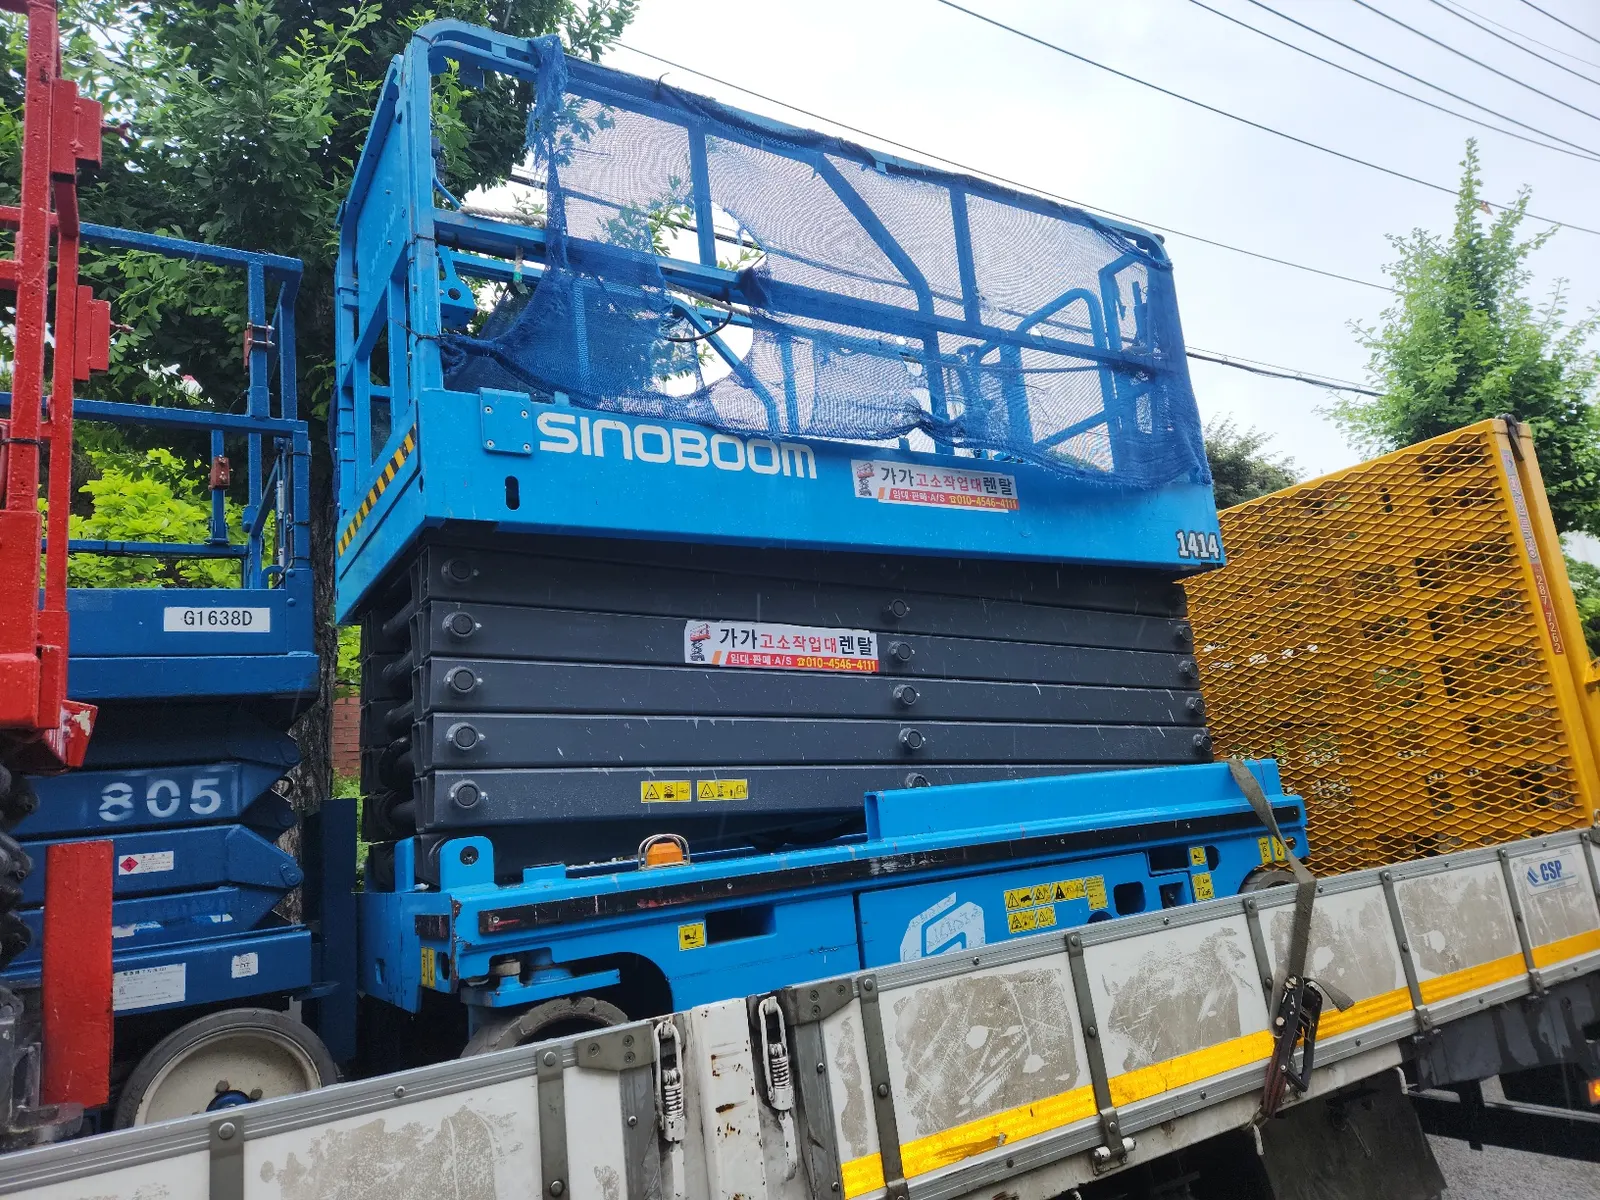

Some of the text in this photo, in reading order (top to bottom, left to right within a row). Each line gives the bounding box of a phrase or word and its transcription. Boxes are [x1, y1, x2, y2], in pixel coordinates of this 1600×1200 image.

[1176, 530, 1220, 560] 1414
[183, 610, 253, 626] G1638D
[99, 777, 222, 822] 805
[1540, 860, 1562, 881] CSP
